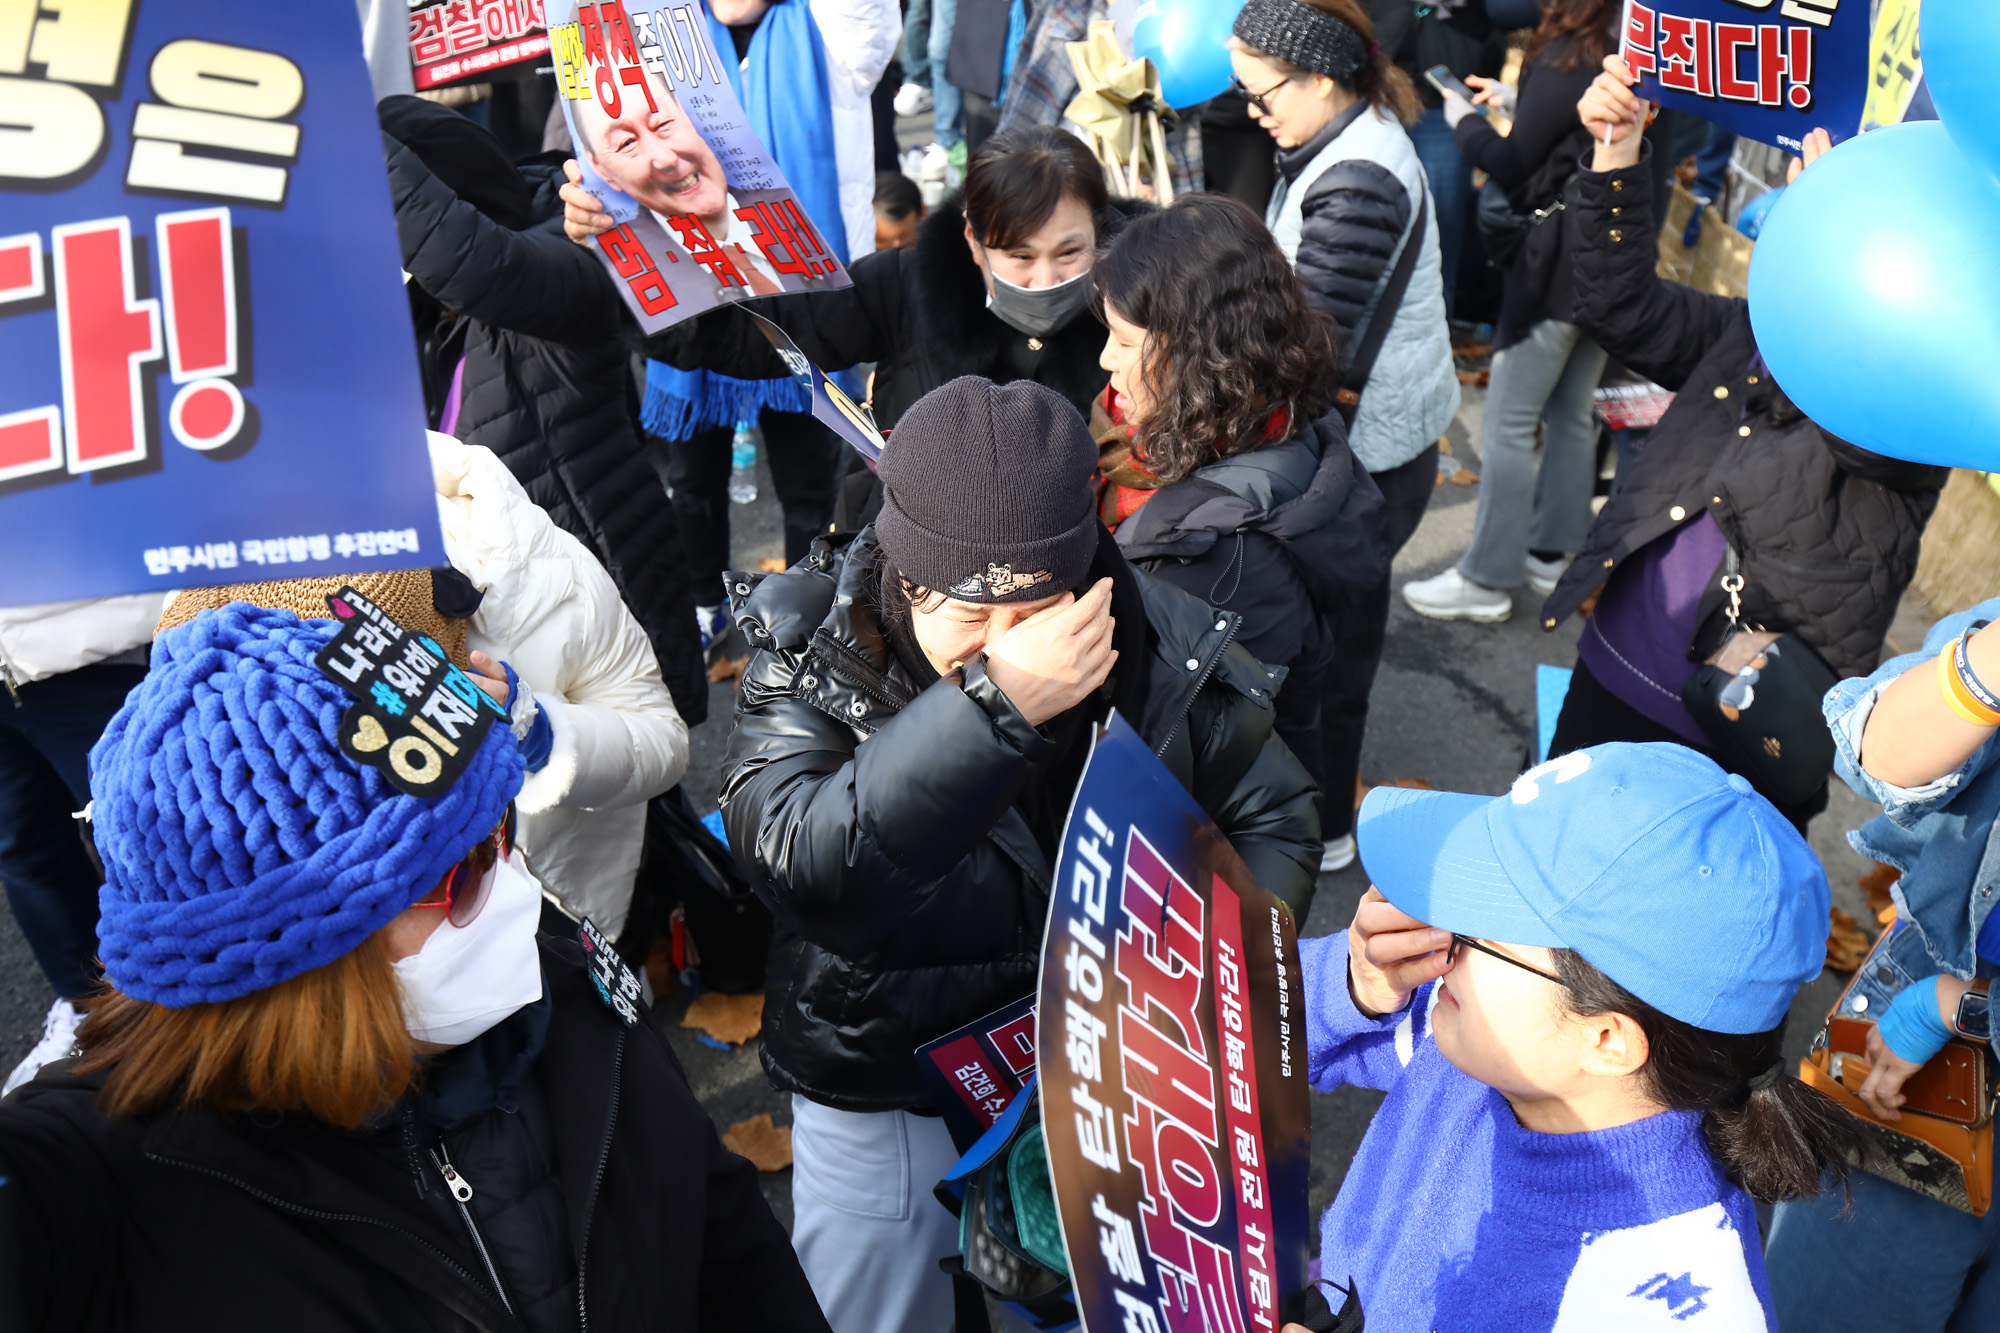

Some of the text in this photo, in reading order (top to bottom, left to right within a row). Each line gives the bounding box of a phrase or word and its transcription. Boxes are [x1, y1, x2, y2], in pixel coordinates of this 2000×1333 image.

[578, 0, 658, 119] 정적
[632, 3, 720, 91] 죽이기
[1623, 0, 1812, 109] 무죄다!
[327, 591, 404, 683] 나라를
[1065, 807, 1121, 1173] 탄핵하라!
[1218, 938, 1252, 1115] 탄핵하라!
[1270, 906, 1292, 1078] 민주시민 국민항쟁 추진연대
[954, 1061, 998, 1101] 김건희
[1234, 1126, 1264, 1211] 전원
